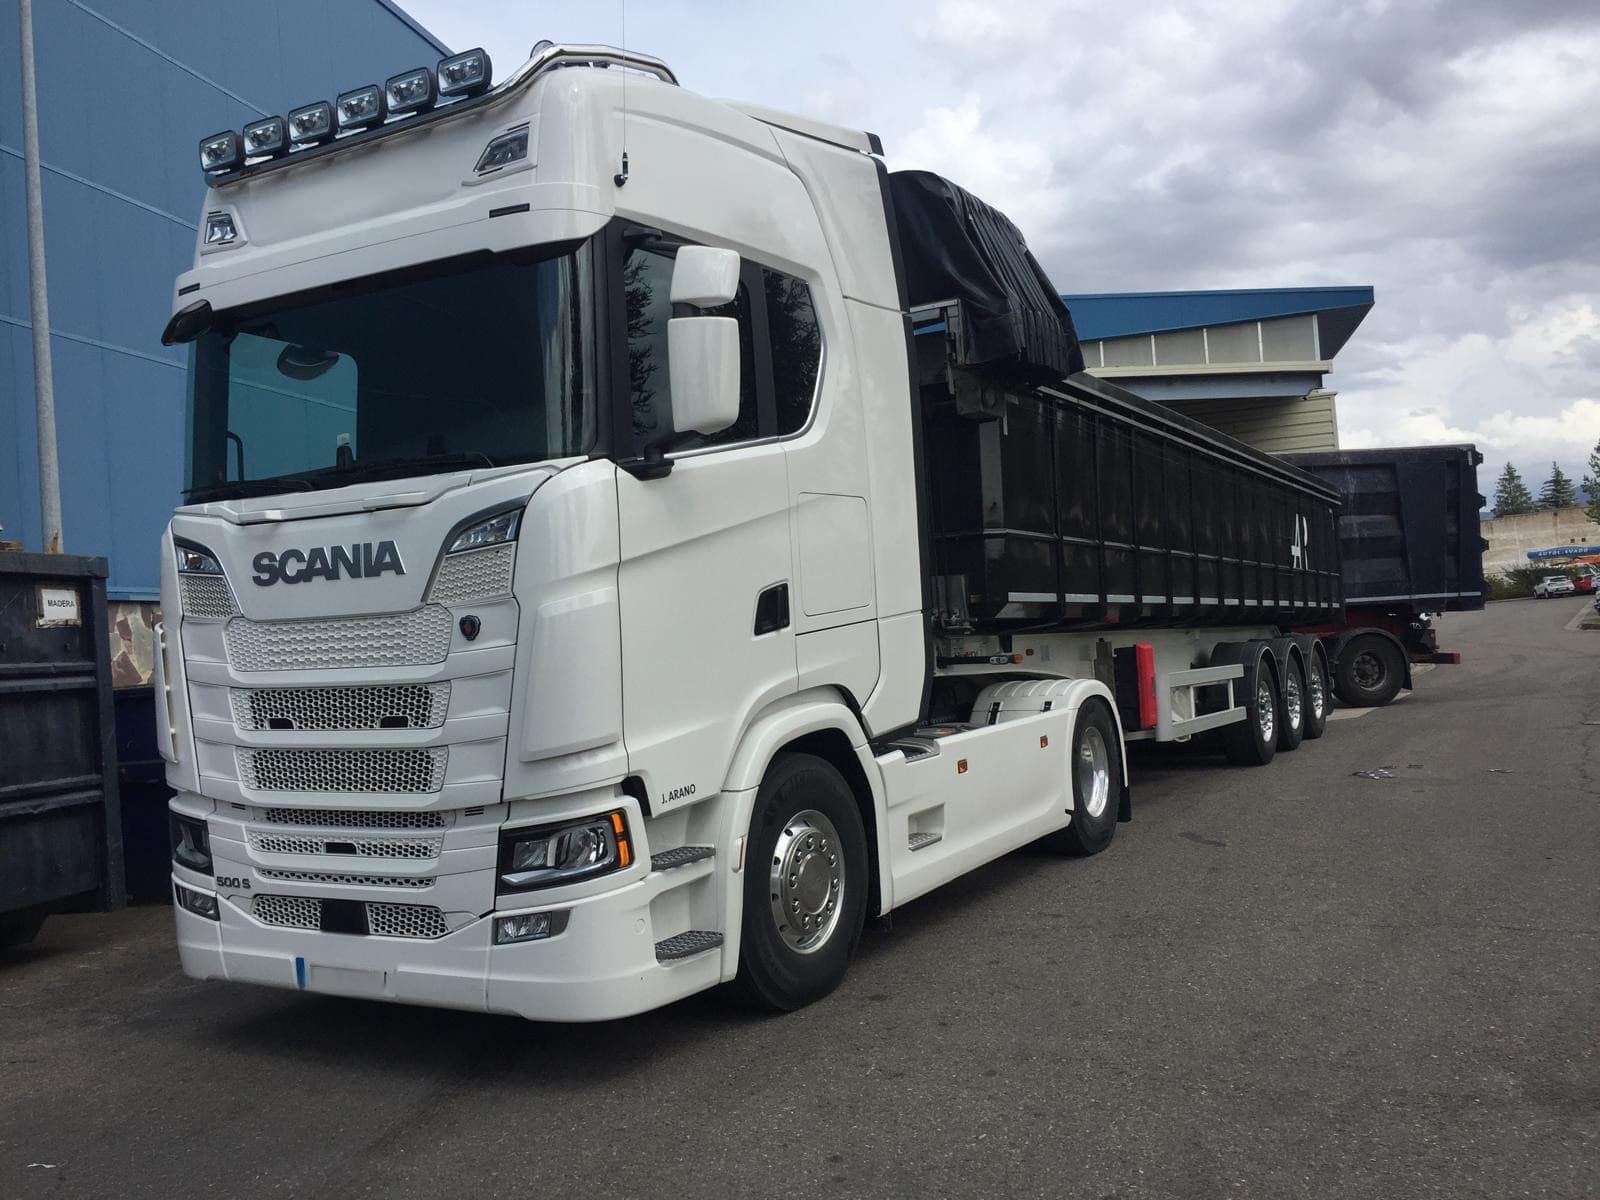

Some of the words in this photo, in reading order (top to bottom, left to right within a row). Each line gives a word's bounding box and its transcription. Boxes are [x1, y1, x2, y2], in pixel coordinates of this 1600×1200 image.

[252, 540, 407, 587] SCANIA
[47, 599, 75, 608] MADERA
[668, 783, 696, 802] ARANO
[216, 876, 241, 888] 500
[242, 878, 251, 889] S
